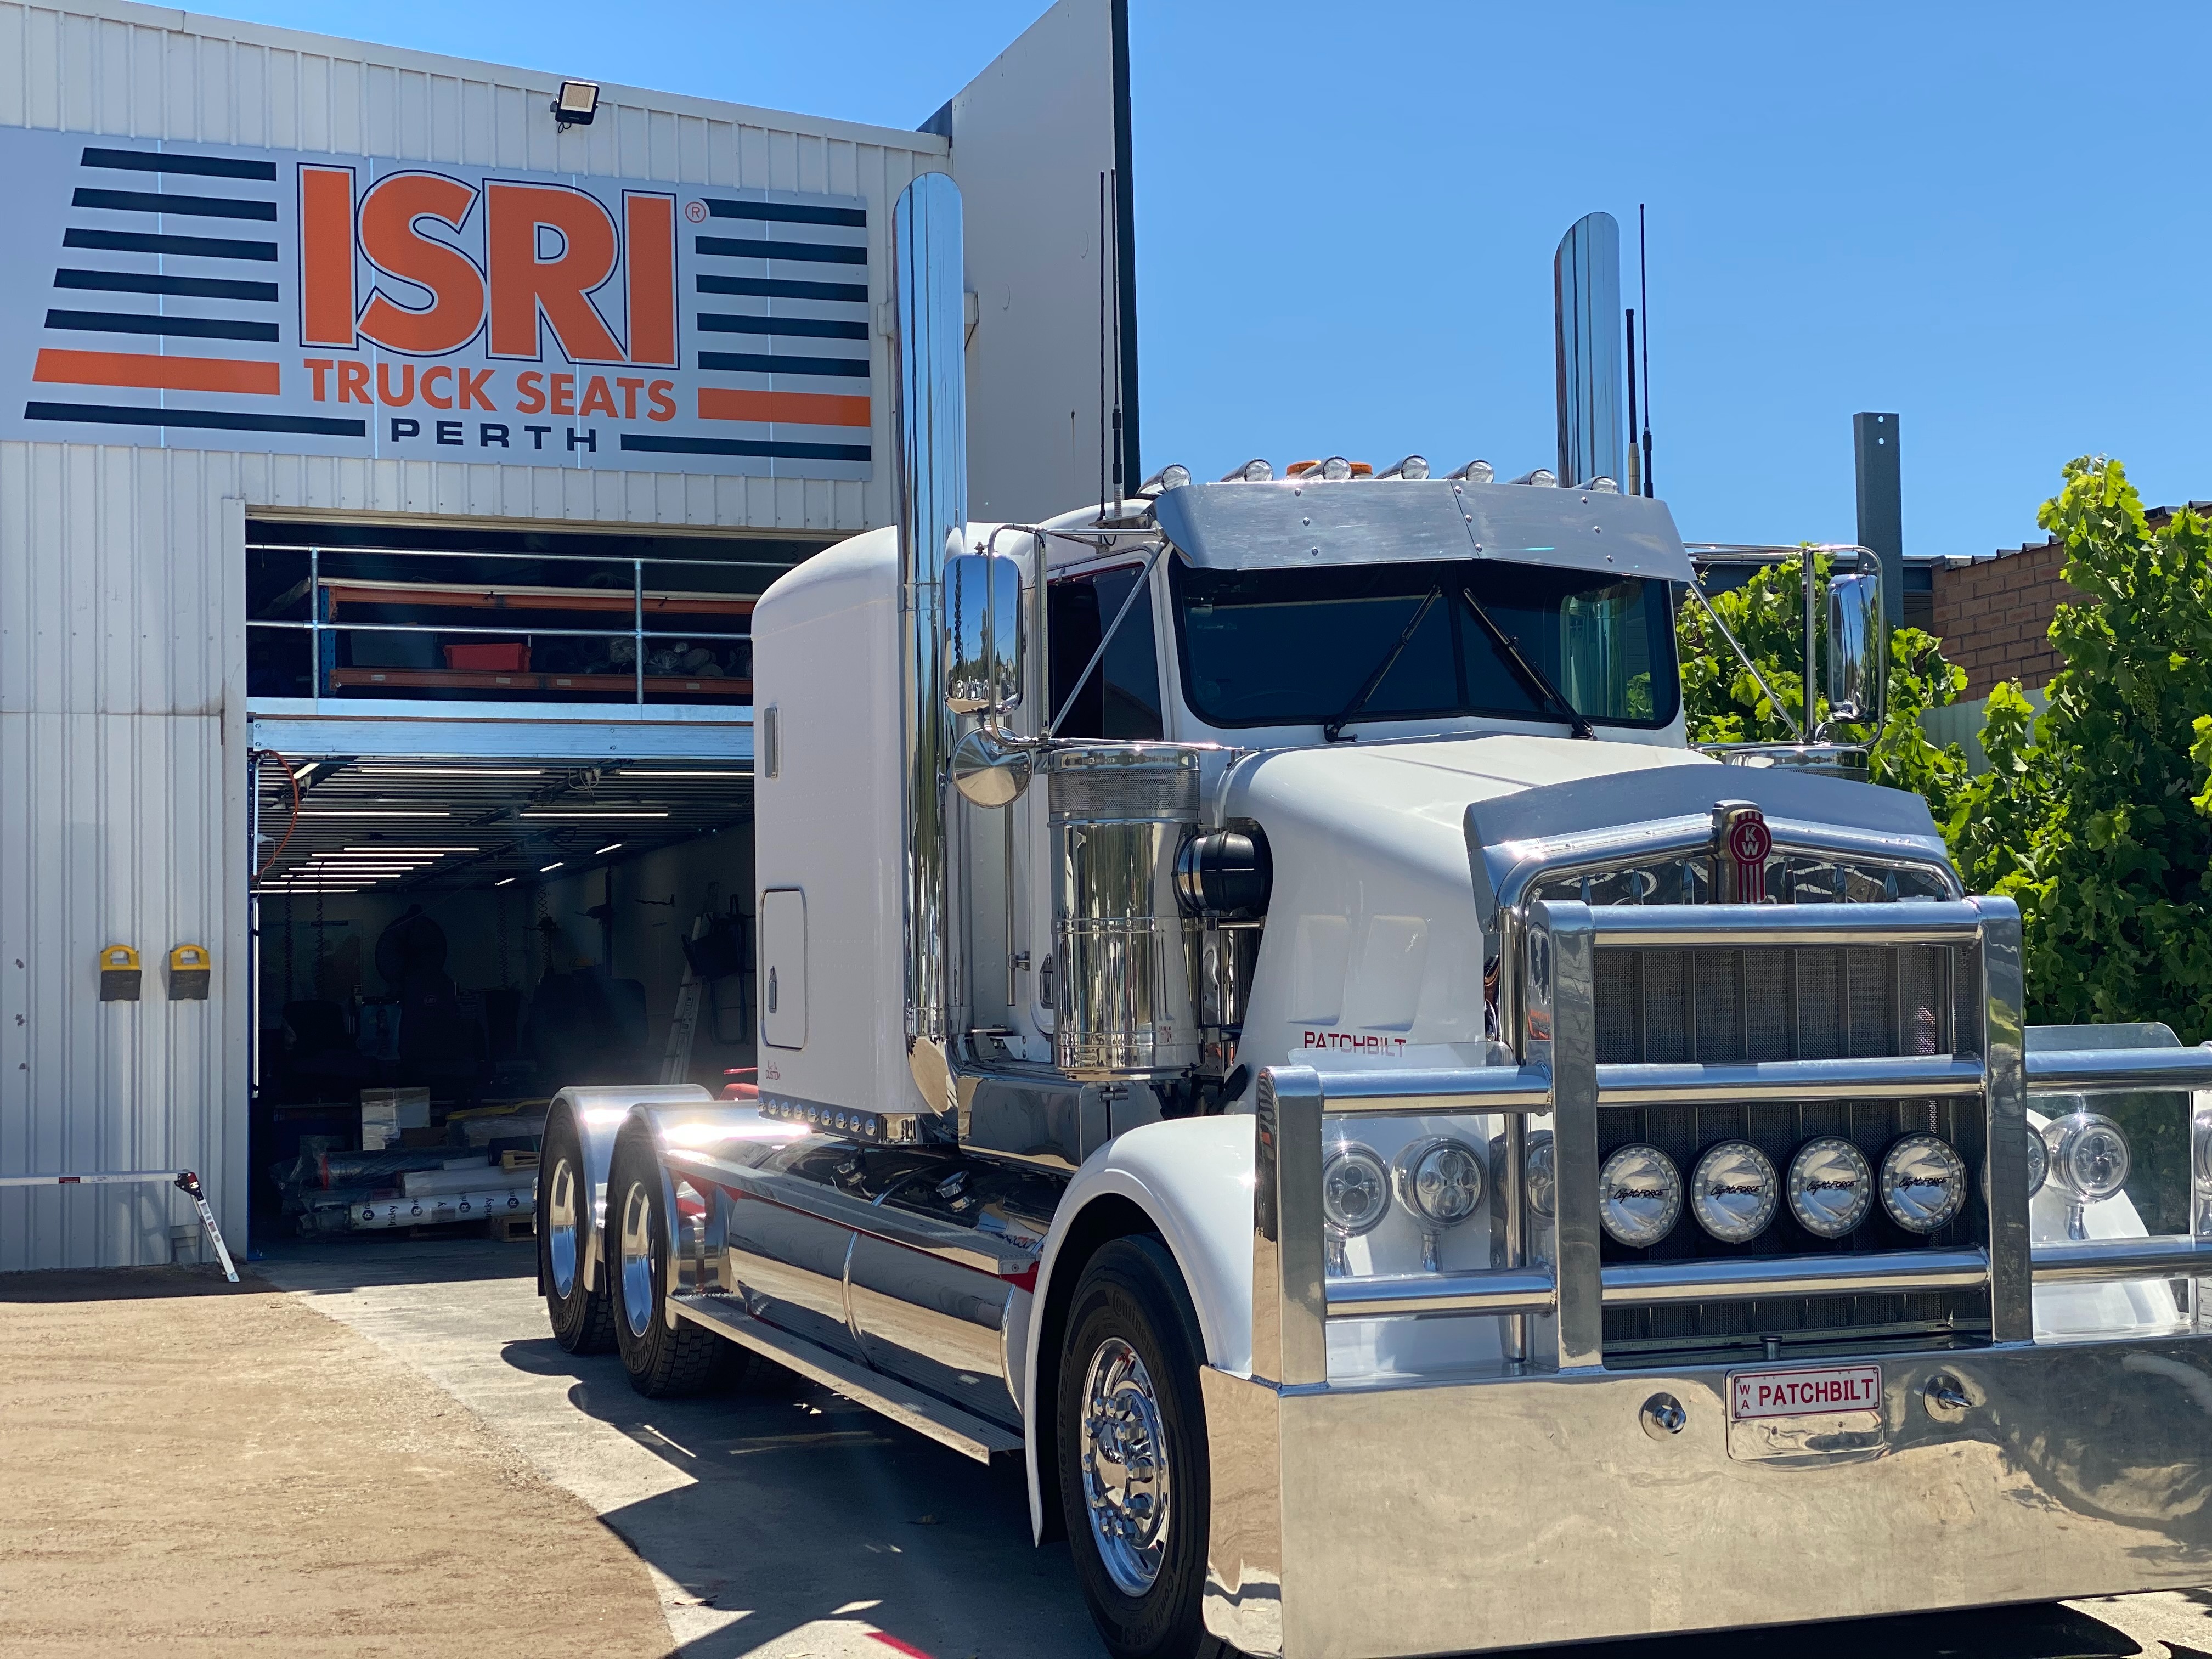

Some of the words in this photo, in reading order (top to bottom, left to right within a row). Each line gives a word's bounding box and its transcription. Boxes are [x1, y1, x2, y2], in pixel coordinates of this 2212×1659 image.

[297, 162, 680, 370] ISRI
[303, 357, 498, 412] TRUCK
[516, 371, 677, 422] SEATS
[391, 417, 597, 453] PERTH
[1304, 1031, 1407, 1058] PATCHBILT
[1112, 1290, 1163, 1386] Continental
[1759, 1379, 1874, 1407] PATCHBILT
